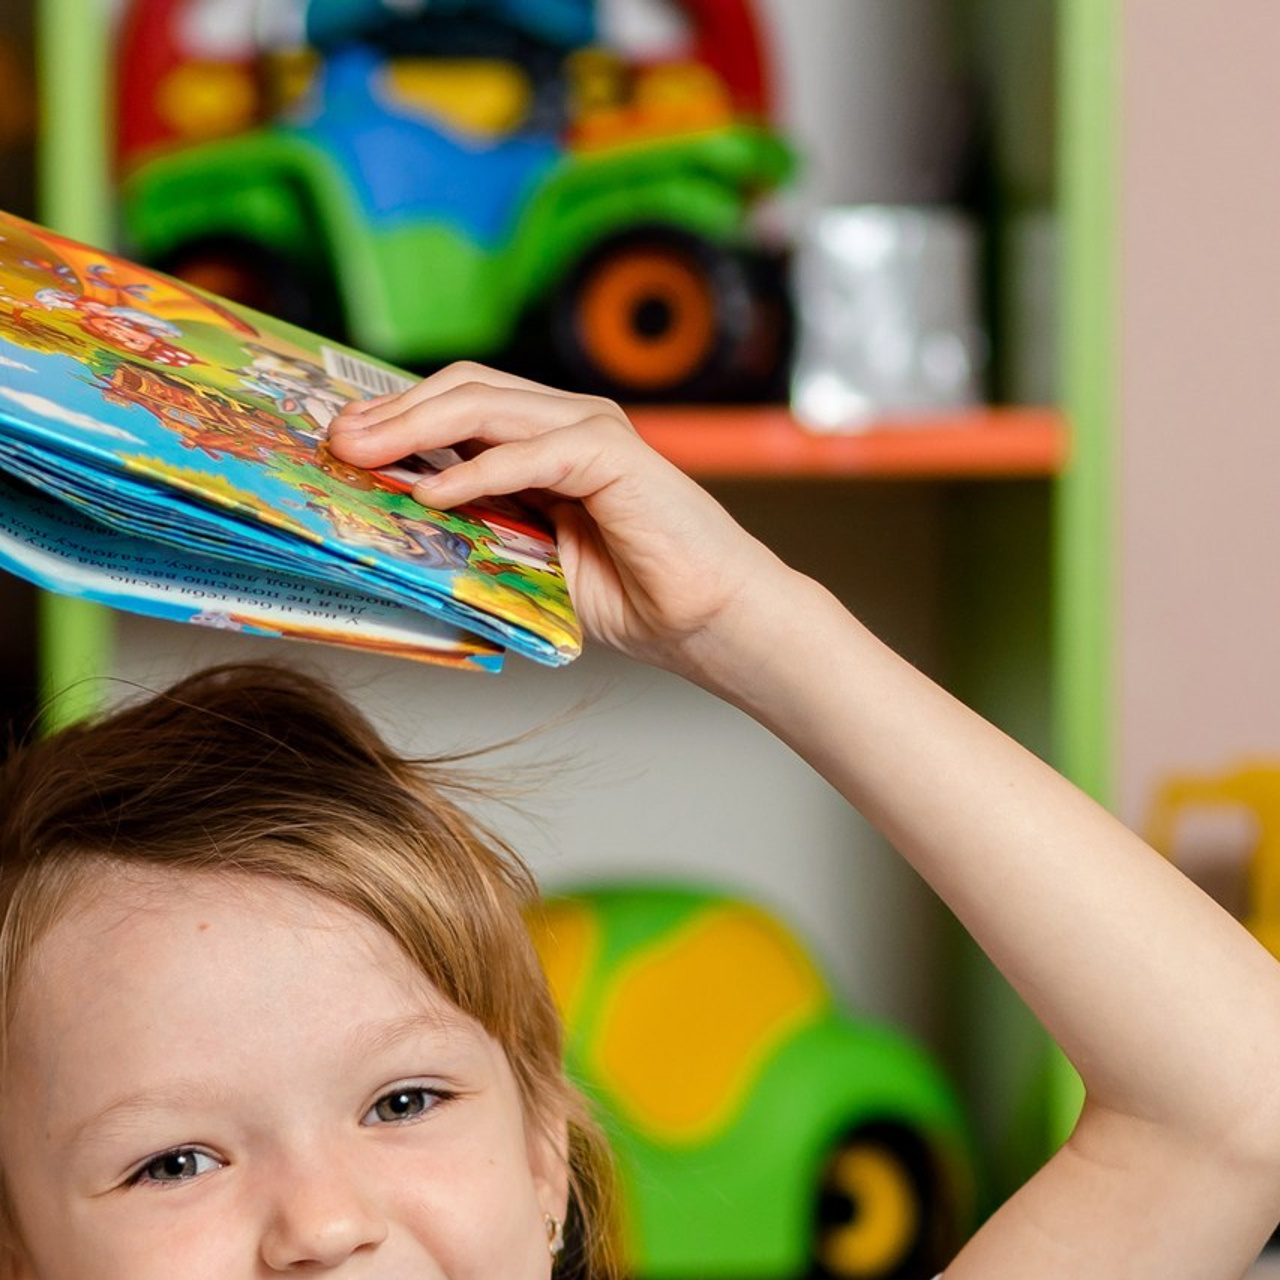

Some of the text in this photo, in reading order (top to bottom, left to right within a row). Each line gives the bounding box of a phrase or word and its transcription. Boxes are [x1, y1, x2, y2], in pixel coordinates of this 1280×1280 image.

[77, 555, 128, 572] сама
[183, 574, 279, 599] потесню
[265, 577, 306, 592] под
[180, 586, 228, 602] тебя
[285, 594, 312, 605] не
[237, 596, 272, 610] без
[337, 603, 368, 615] Да
[300, 608, 337, 620] нас
